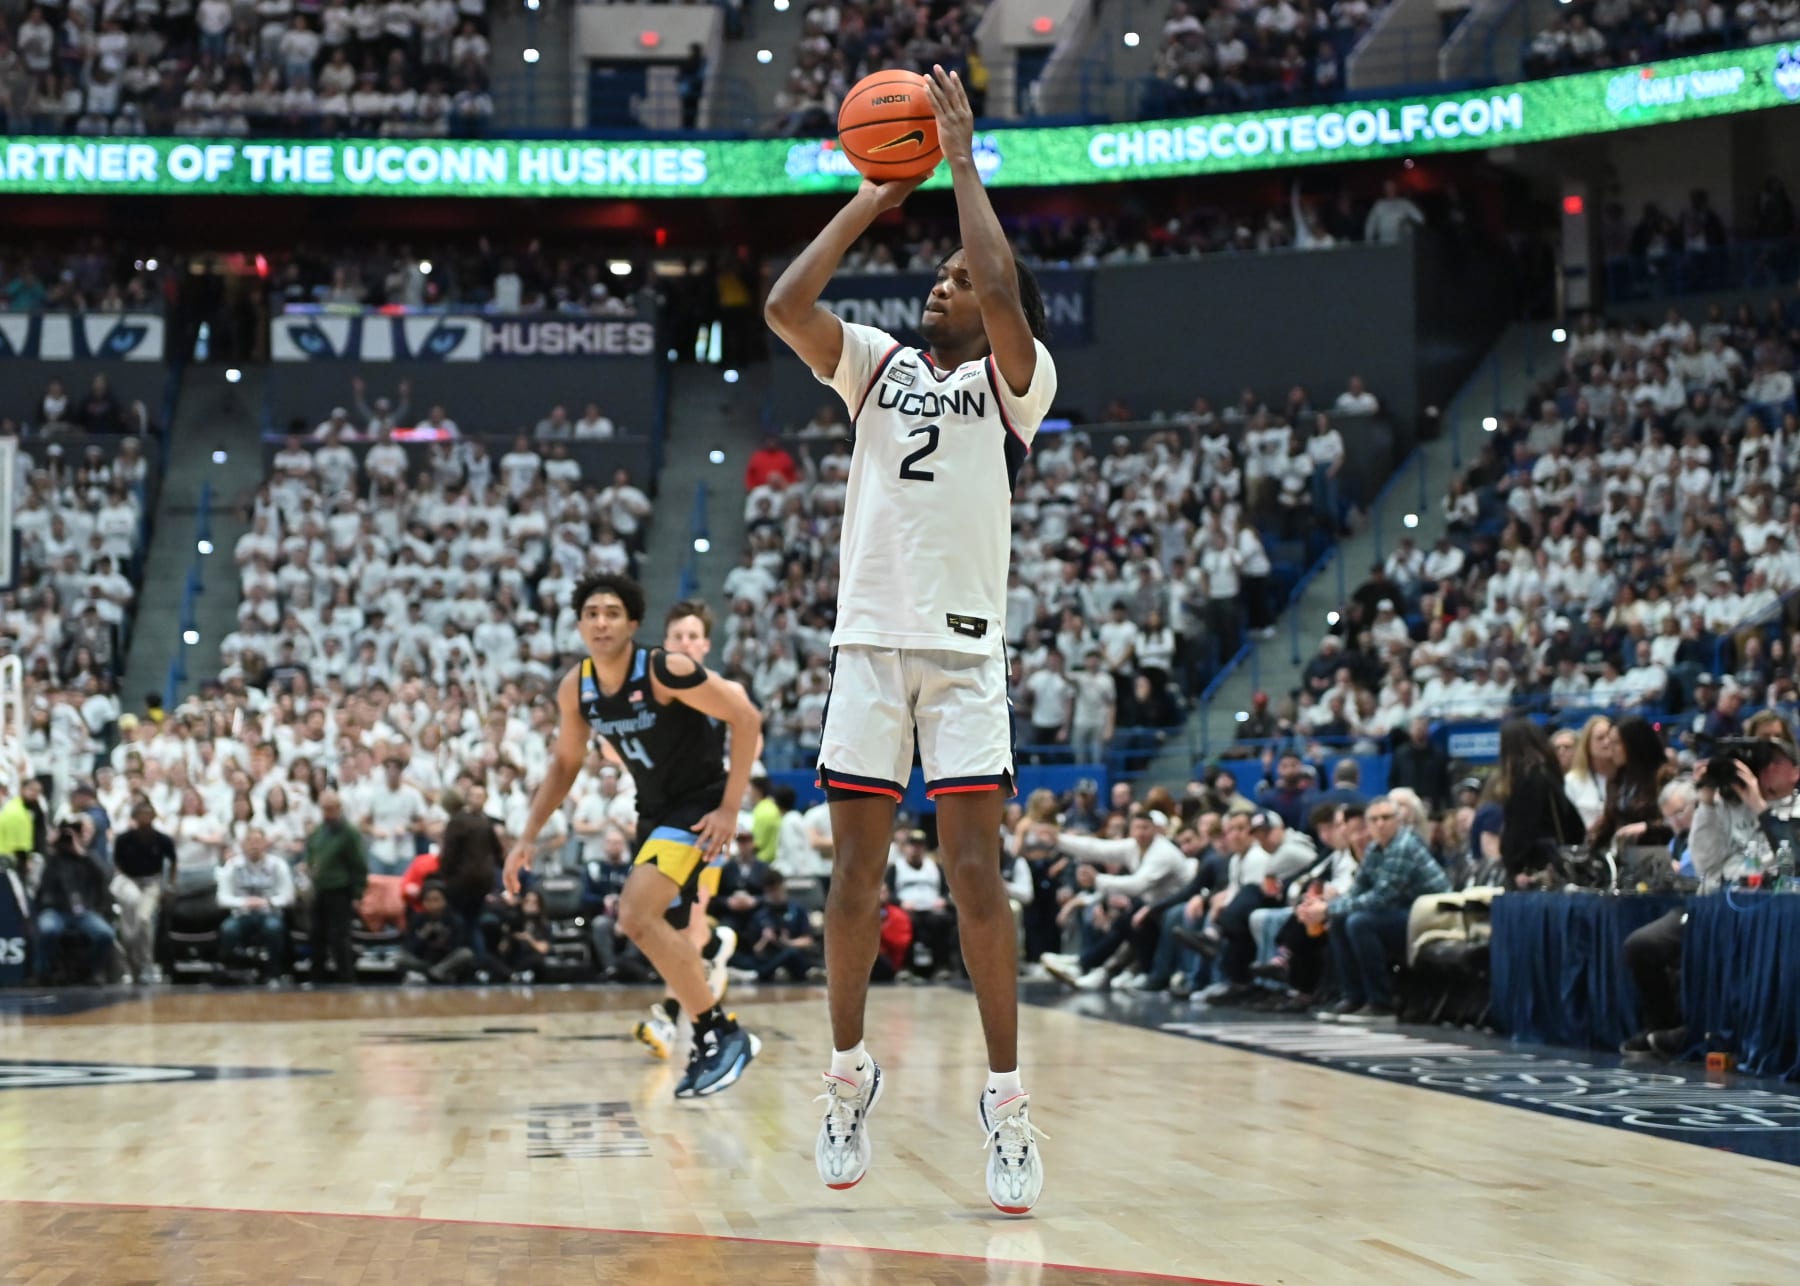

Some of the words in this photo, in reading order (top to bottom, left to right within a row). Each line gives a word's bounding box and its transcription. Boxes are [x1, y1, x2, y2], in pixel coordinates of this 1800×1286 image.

[871, 94, 911, 106] UCONN
[1088, 93, 1523, 166] CHRISCOTEGOLF.COM
[0, 143, 158, 181] RTNER
[167, 143, 232, 182] OF
[243, 145, 332, 181] THE
[343, 146, 507, 182] UCONN
[519, 147, 706, 183] HUSKIES
[818, 297, 922, 329] ONN
[483, 320, 655, 355] HUSKIES
[878, 383, 985, 418] UCONN
[899, 424, 939, 482] 2
[620, 737, 654, 769] 4
